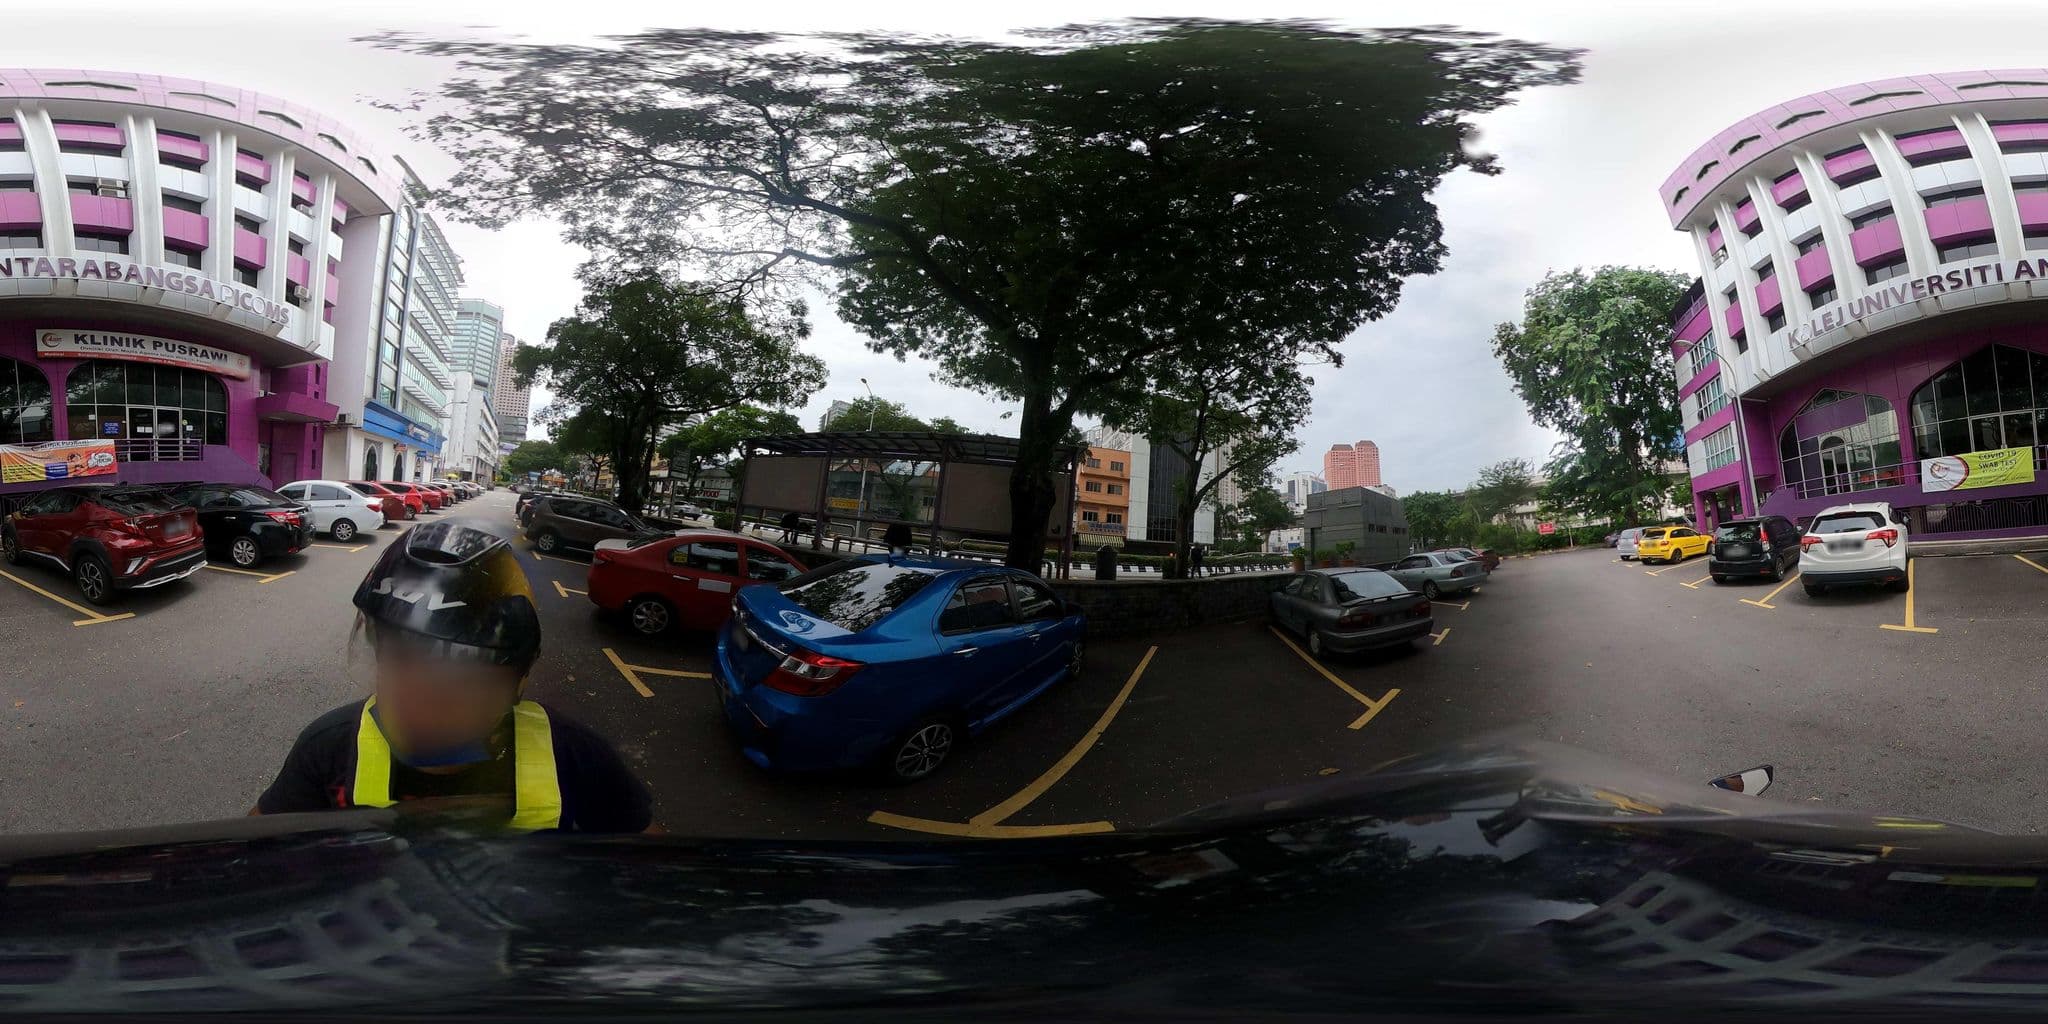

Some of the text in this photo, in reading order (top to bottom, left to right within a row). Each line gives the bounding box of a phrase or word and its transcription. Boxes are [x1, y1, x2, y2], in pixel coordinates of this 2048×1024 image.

[221, 284, 290, 325] PICOMS
[1788, 306, 1845, 348] KOLEJ
[1849, 263, 2003, 320] UNIVERSITI
[74, 333, 145, 349] KLINIK
[153, 340, 228, 363] PUSRAWI
[1978, 451, 2004, 460] COVID
[1978, 459, 2017, 469] SWAB TEST
